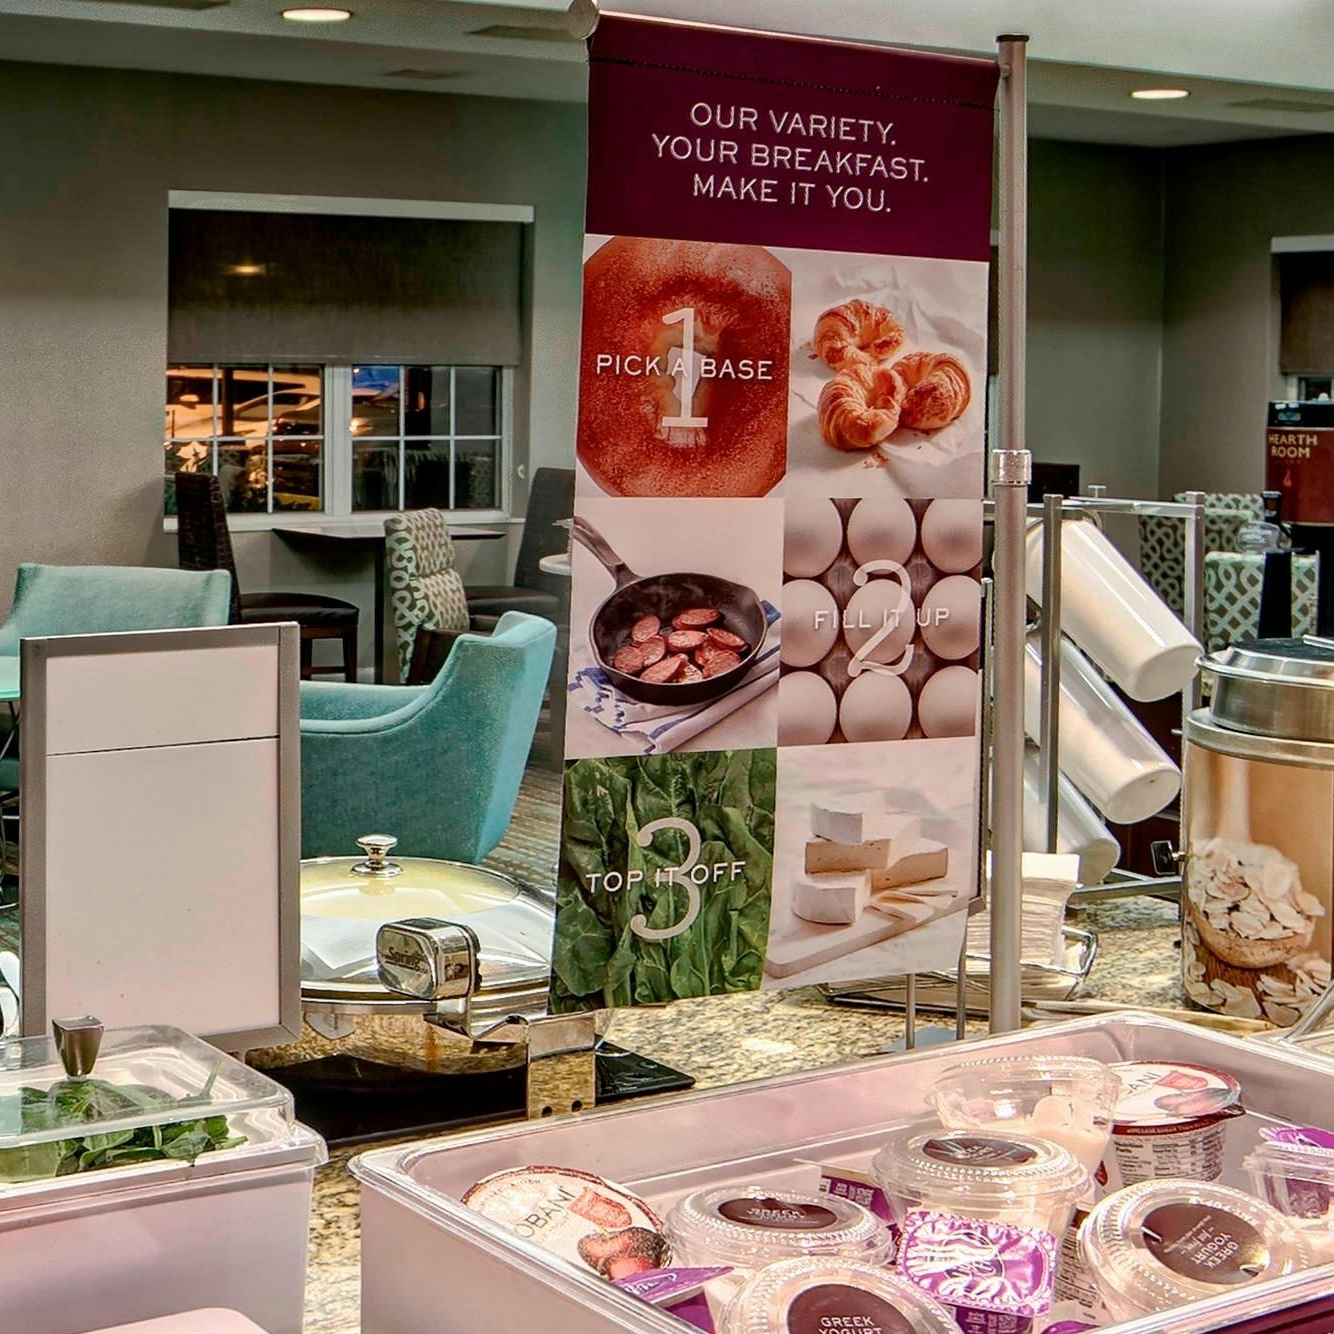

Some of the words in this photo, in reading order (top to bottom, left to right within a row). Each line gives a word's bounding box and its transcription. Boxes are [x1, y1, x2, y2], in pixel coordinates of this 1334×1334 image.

[691, 102, 758, 131] OUR
[768, 110, 897, 146] VARIETY.
[652, 134, 738, 164] YOUR
[751, 143, 929, 182] BREAKFAST.
[693, 173, 778, 202] MAKE
[790, 182, 816, 205] IT
[826, 185, 891, 213] YOU.
[596, 354, 661, 376] PICK
[671, 358, 688, 377] A
[701, 358, 774, 380] BASE
[662, 307, 708, 428] 1
[1267, 433, 1318, 446] HEARTH
[1270, 446, 1311, 459] ROOM
[814, 610, 872, 629] FILL
[883, 609, 905, 628] IT
[916, 608, 950, 627] UP
[847, 559, 915, 678] 2
[585, 870, 643, 894] TOP
[655, 866, 680, 888] IT
[690, 861, 746, 885] OFF
[630, 816, 702, 940] 3
[1190, 1232, 1232, 1264] YOGURT
[1203, 1241, 1239, 1269] GREEK
[820, 1315, 875, 1327] GREEK
